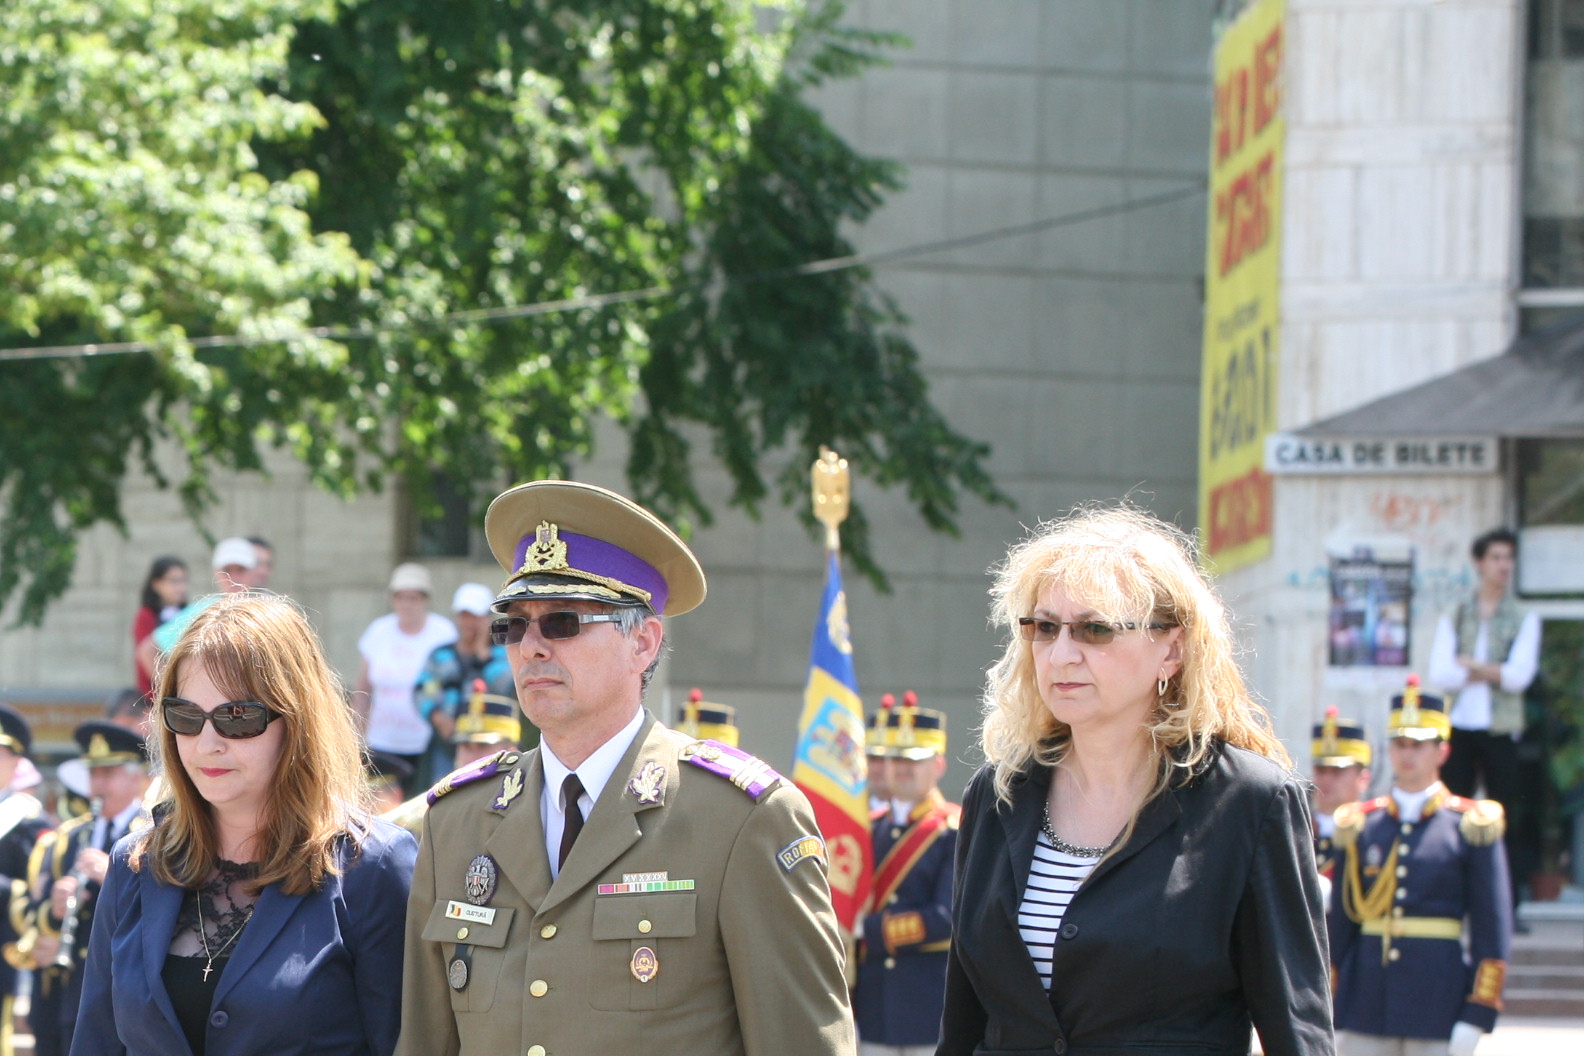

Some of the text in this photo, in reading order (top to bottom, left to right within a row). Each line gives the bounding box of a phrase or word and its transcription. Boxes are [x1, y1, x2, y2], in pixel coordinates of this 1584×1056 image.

[1275, 441, 1484, 465] CASA DE BILETE
